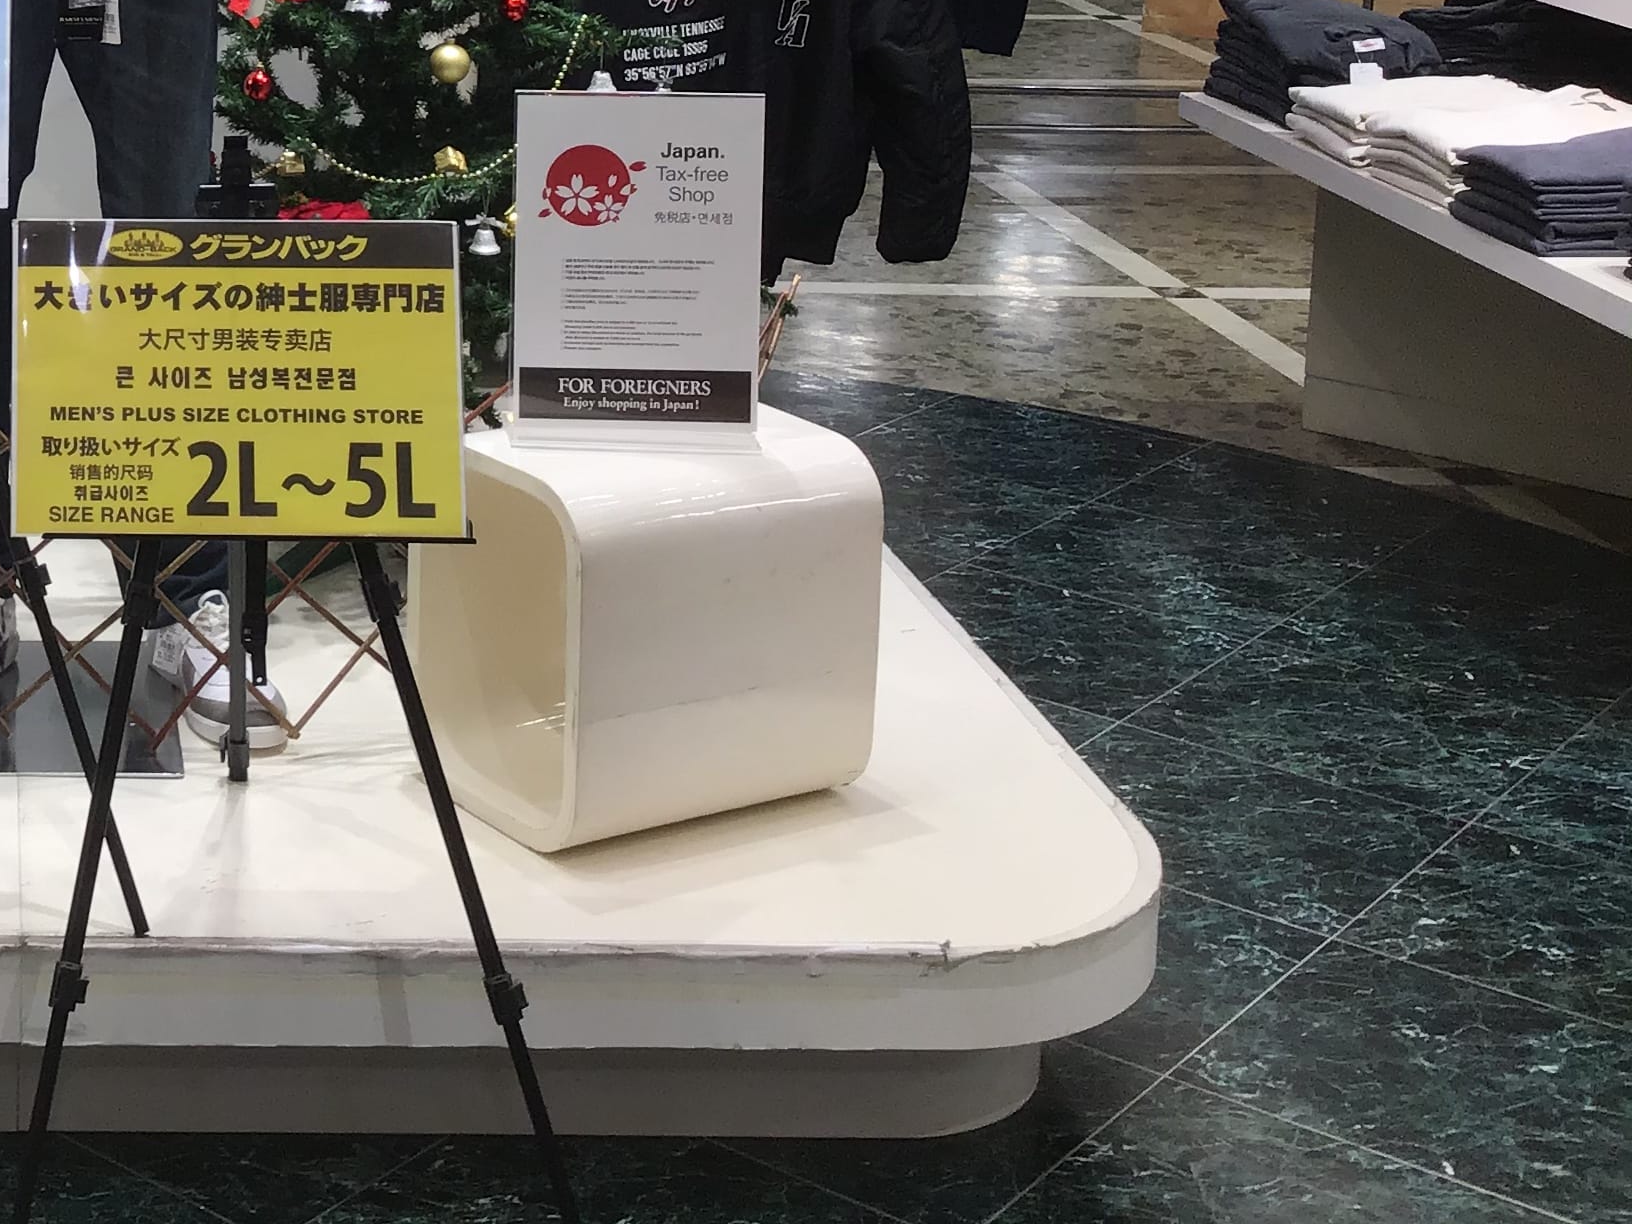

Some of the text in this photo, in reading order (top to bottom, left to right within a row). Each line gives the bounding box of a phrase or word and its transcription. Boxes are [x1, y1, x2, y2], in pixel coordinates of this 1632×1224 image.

[623, 47, 651, 62] CAGE
[660, 142, 725, 162] Japan.
[655, 165, 729, 182] Tax-free
[668, 186, 715, 206] Shop
[189, 234, 368, 262] グランバック
[138, 328, 333, 353] 大尺寸男装专卖店
[115, 365, 357, 392] 큰 사이즈 남성복전문점
[558, 377, 712, 396] FOR FOREIGNERS
[563, 397, 596, 410] Enjoy
[597, 397, 648, 412] shopping
[649, 398, 661, 409] in
[121, 407, 177, 423] PLUS
[183, 408, 231, 423] SIZE
[236, 408, 347, 425] CLOTHING
[353, 409, 424, 425] STORE
[41, 436, 181, 458] 取り扱いサイズ
[69, 464, 154, 481] 销售的尺码
[73, 485, 149, 502] 취급사이즈
[49, 506, 175, 523] SIZE RANGE
